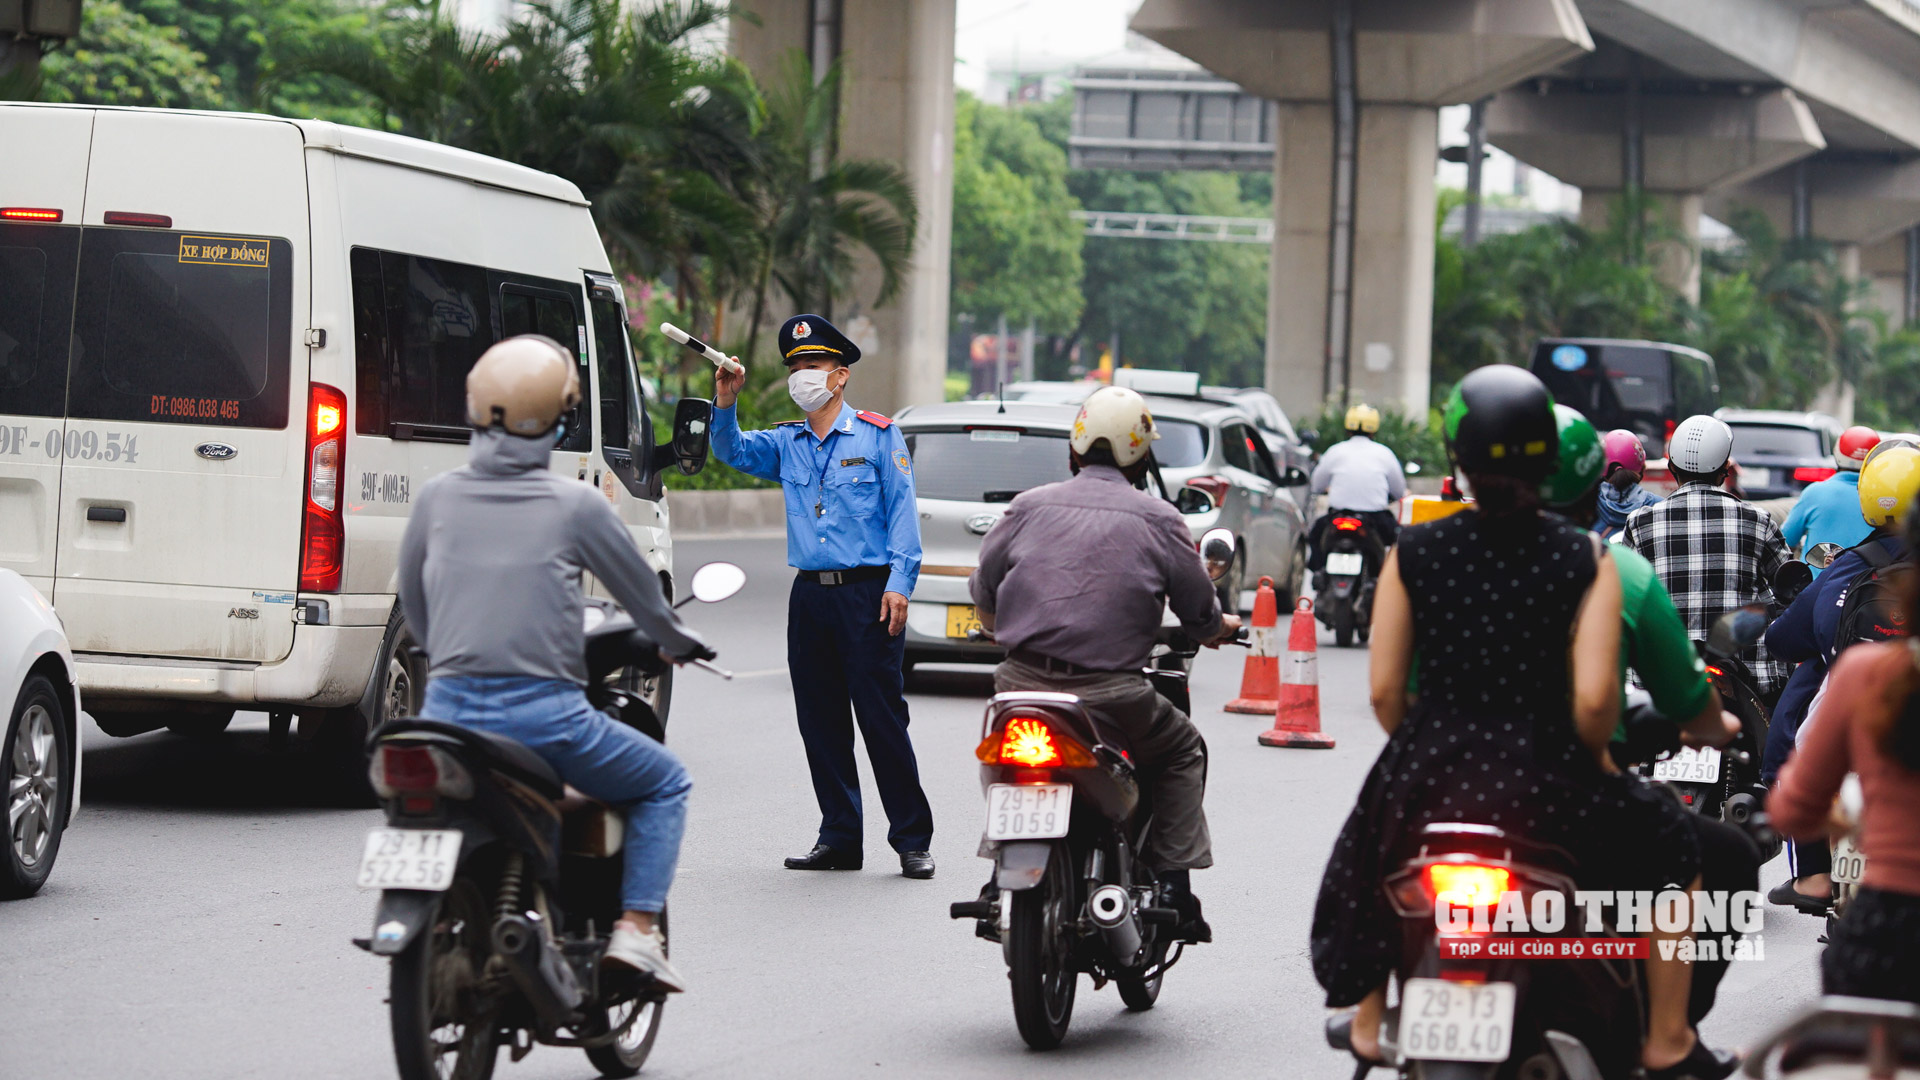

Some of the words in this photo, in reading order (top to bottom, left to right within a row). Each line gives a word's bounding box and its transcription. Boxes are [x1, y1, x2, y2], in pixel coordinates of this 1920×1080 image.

[182, 244, 199, 258] XE
[201, 244, 228, 262] HỢP
[230, 241, 266, 262] ĐỒNG
[170, 396, 218, 418] 0986.038
[219, 400, 239, 419] 465
[203, 444, 229, 456] Ford
[228, 607, 259, 620] ABS
[1658, 761, 1716, 780] 357.50
[1000, 788, 1059, 811] 29-P1
[996, 812, 1056, 835] 3059
[1837, 856, 1868, 880] 00
[1408, 1022, 1502, 1055] 668.40
